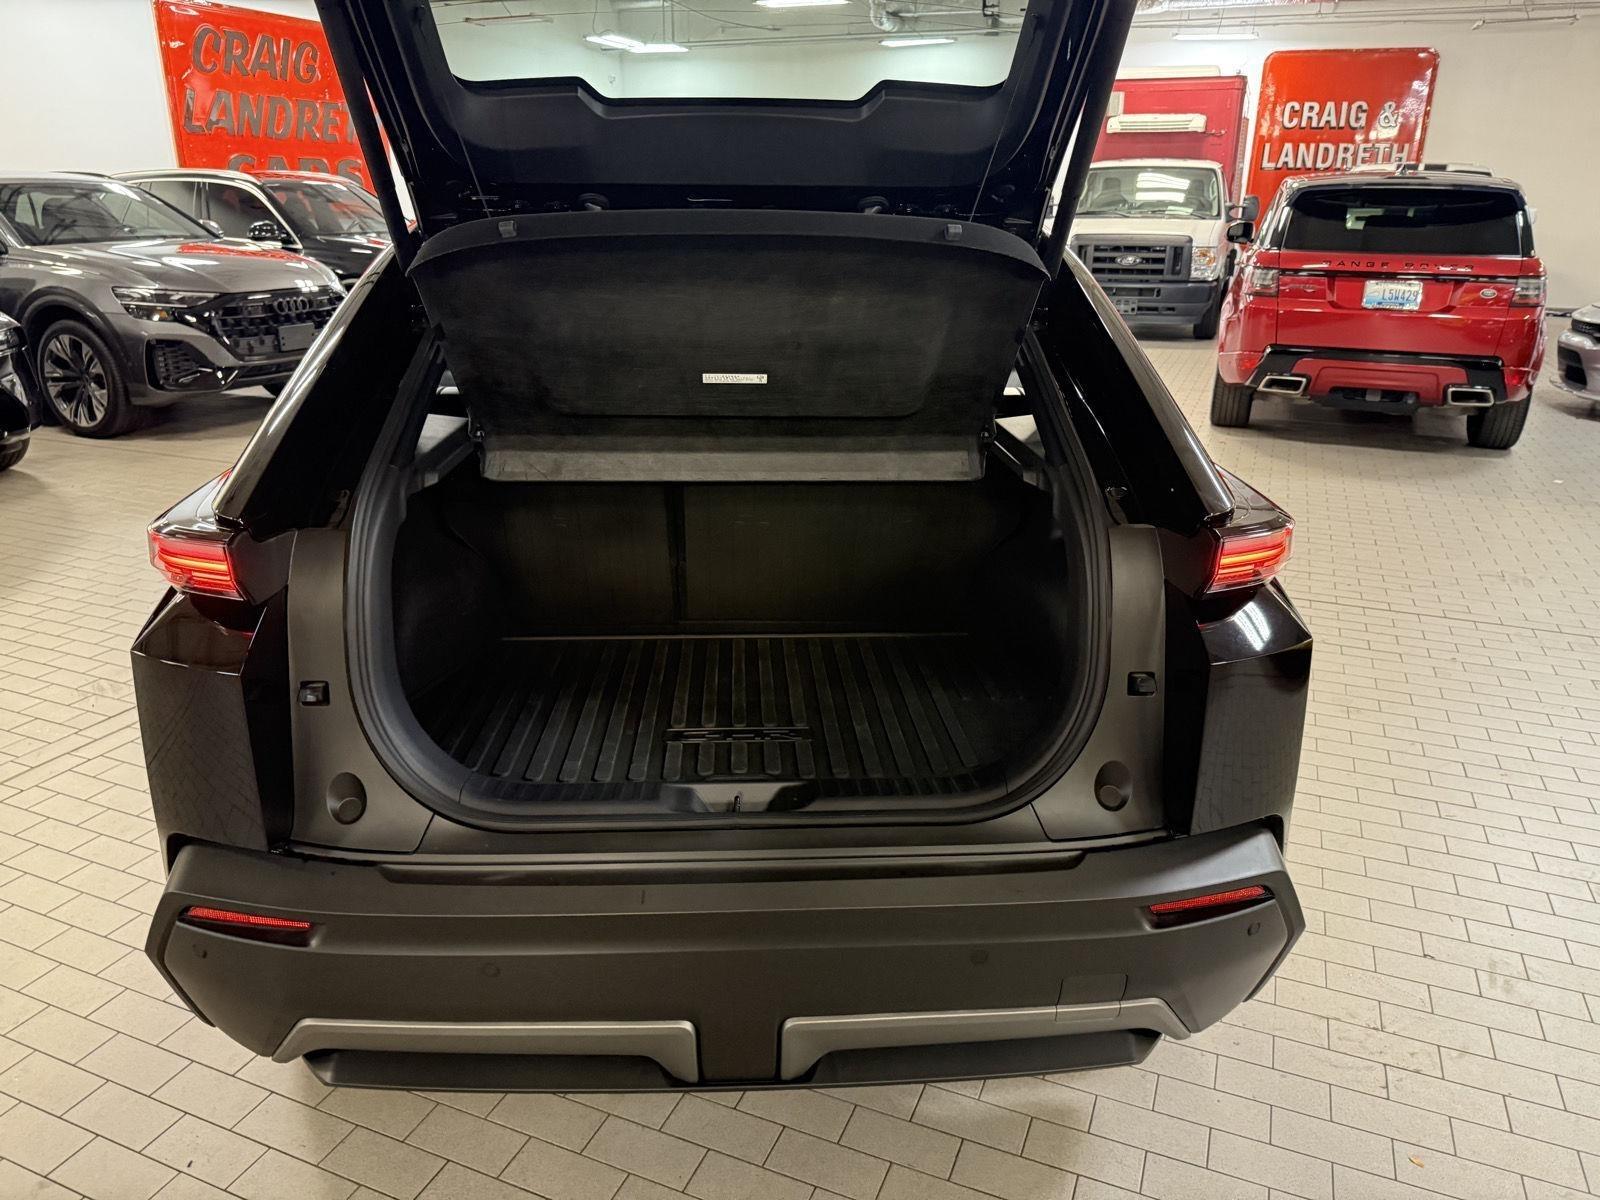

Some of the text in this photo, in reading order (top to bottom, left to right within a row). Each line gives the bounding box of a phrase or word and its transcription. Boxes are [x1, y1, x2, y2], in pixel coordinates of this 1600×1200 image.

[192, 24, 320, 83] CRAIG
[1282, 101, 1399, 130] CRAIG &
[1260, 142, 1410, 171] LANDRETH
[1382, 289, 1418, 301] L5W429
